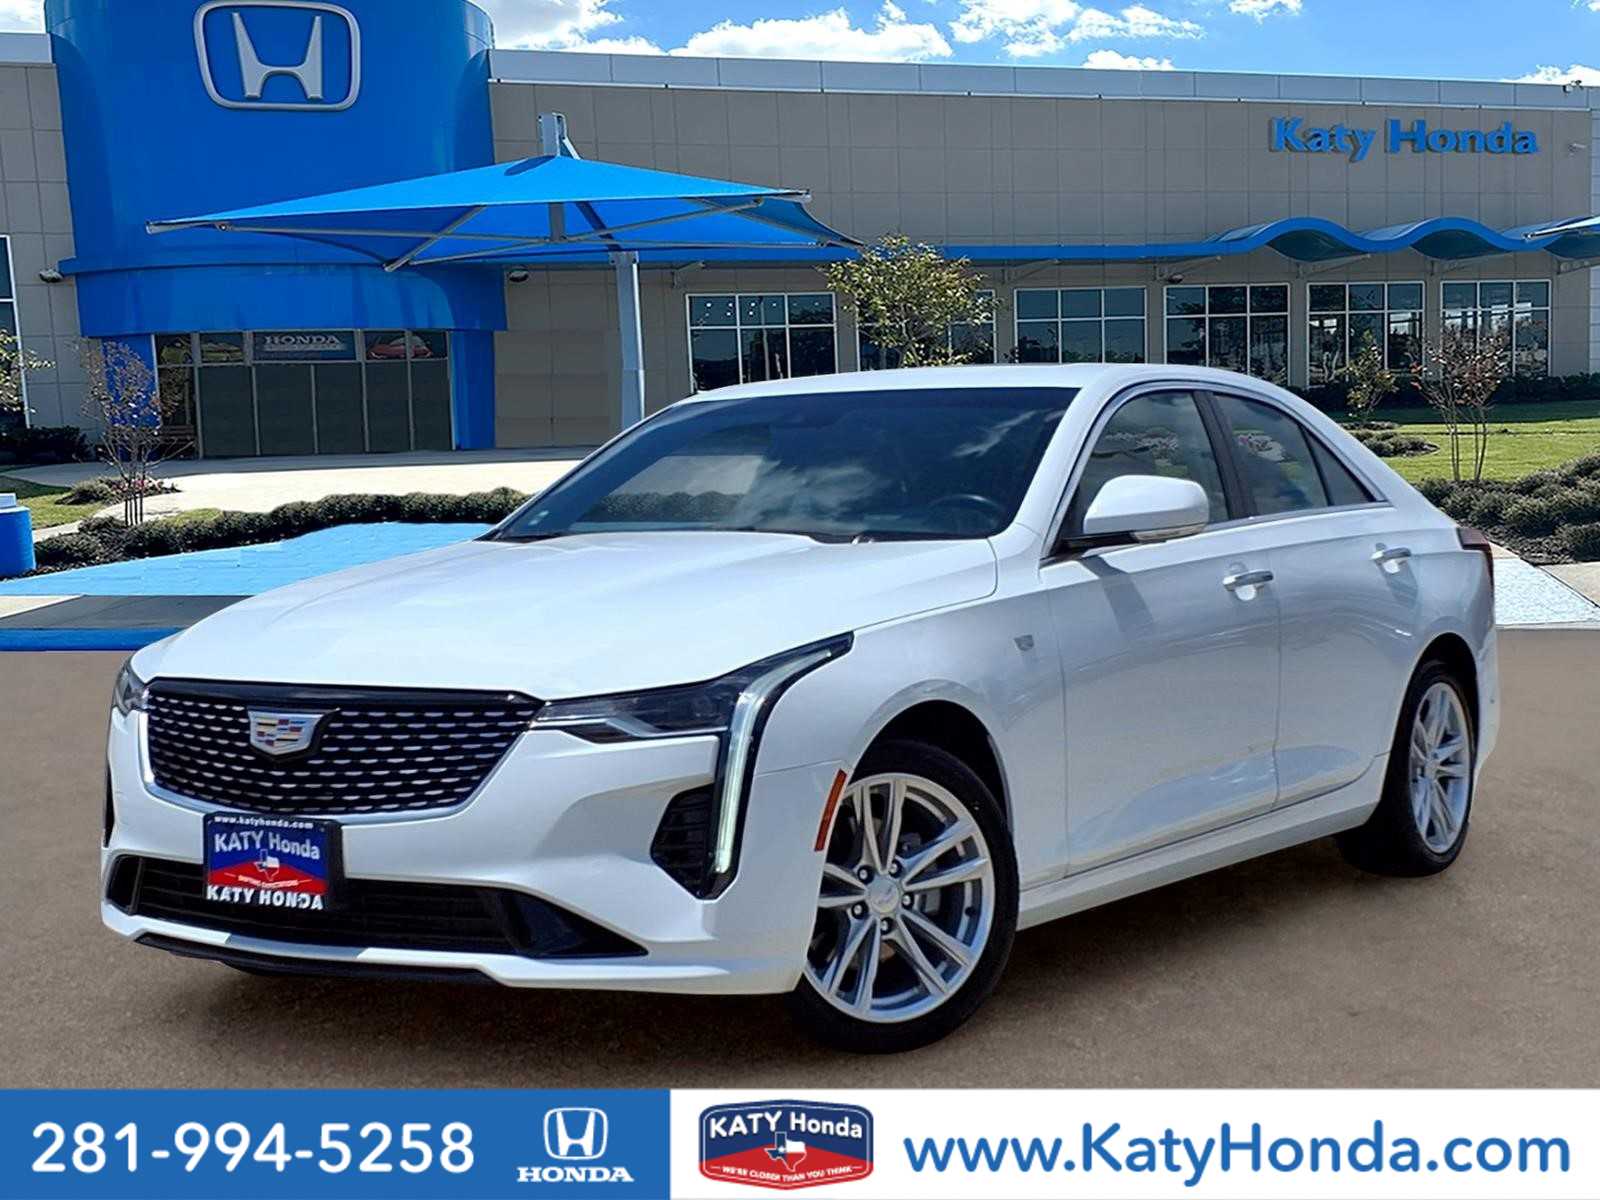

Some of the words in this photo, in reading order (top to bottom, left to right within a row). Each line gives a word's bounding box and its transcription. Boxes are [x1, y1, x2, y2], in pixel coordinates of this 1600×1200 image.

[1270, 116, 1376, 163] Katy
[1386, 119, 1540, 154] Honda
[264, 334, 341, 345] HONDA
[214, 816, 314, 829] www.katyhonda.com
[214, 830, 264, 853] KATY
[268, 832, 320, 860] Honda
[206, 885, 255, 904] KATY
[258, 890, 324, 910] HONDA
